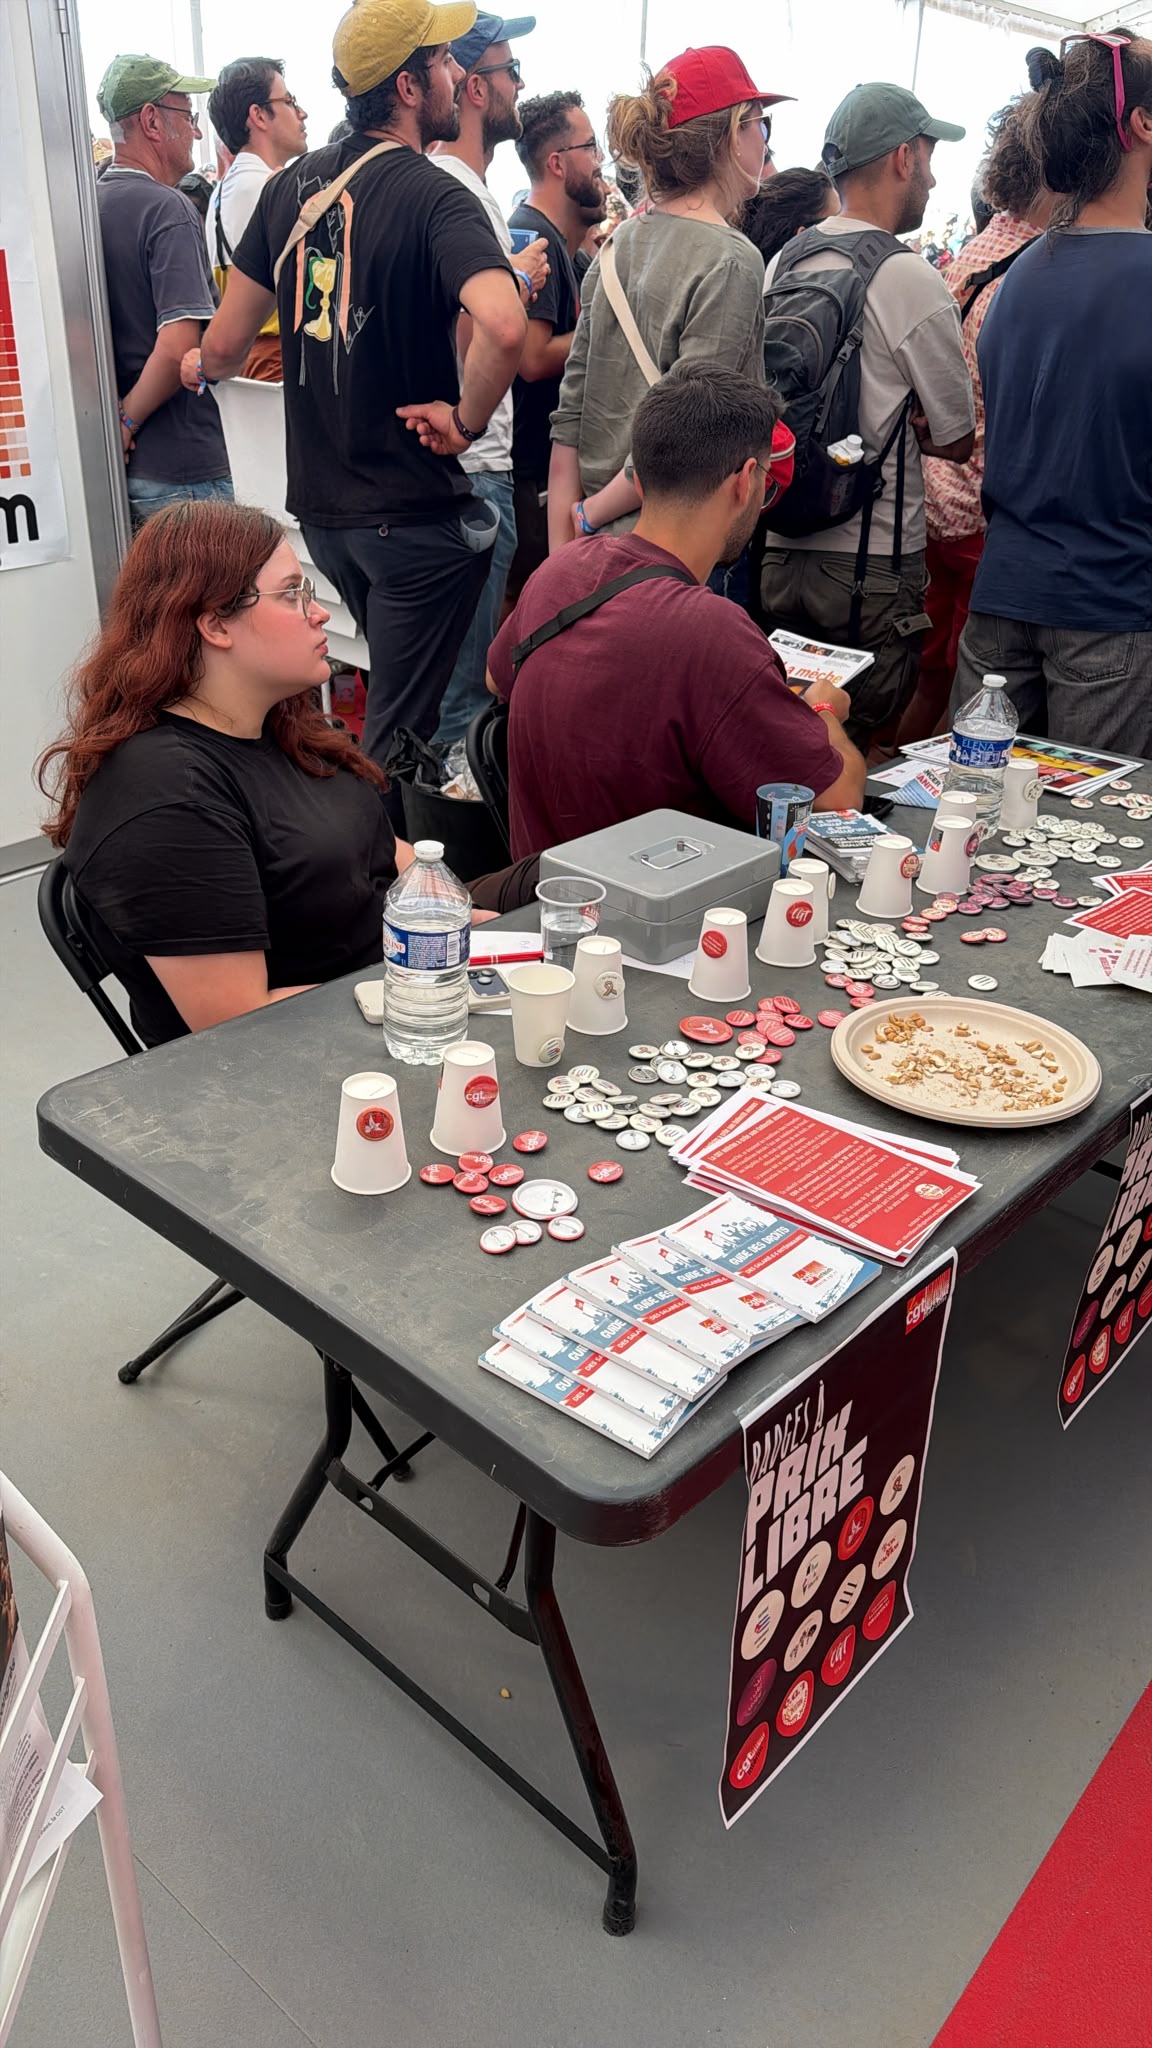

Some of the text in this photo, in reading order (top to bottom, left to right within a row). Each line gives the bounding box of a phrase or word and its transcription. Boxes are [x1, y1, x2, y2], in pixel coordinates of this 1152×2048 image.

[961, 738, 995, 751] ELENA
[922, 768, 942, 788] NCER
[791, 908, 812, 922] CGT
[466, 1090, 485, 1103] cgt
[729, 1226, 790, 1266] GUIDE DES DROITS
[677, 1269, 704, 1282] GUIDE
[633, 1296, 659, 1311] GUIDE
[906, 1298, 926, 1326] cgt
[600, 1319, 627, 1338] GUIDE
[617, 1338, 629, 1348] DES
[585, 1361, 597, 1371] DES
[555, 1376, 574, 1391] GUI
[572, 1391, 585, 1401] DES
[751, 1379, 825, 1485] BADGES À
[746, 1400, 853, 1552] PRIX
[741, 1435, 868, 1613] LIBRE
[55, 1805, 66, 1817] CGT
